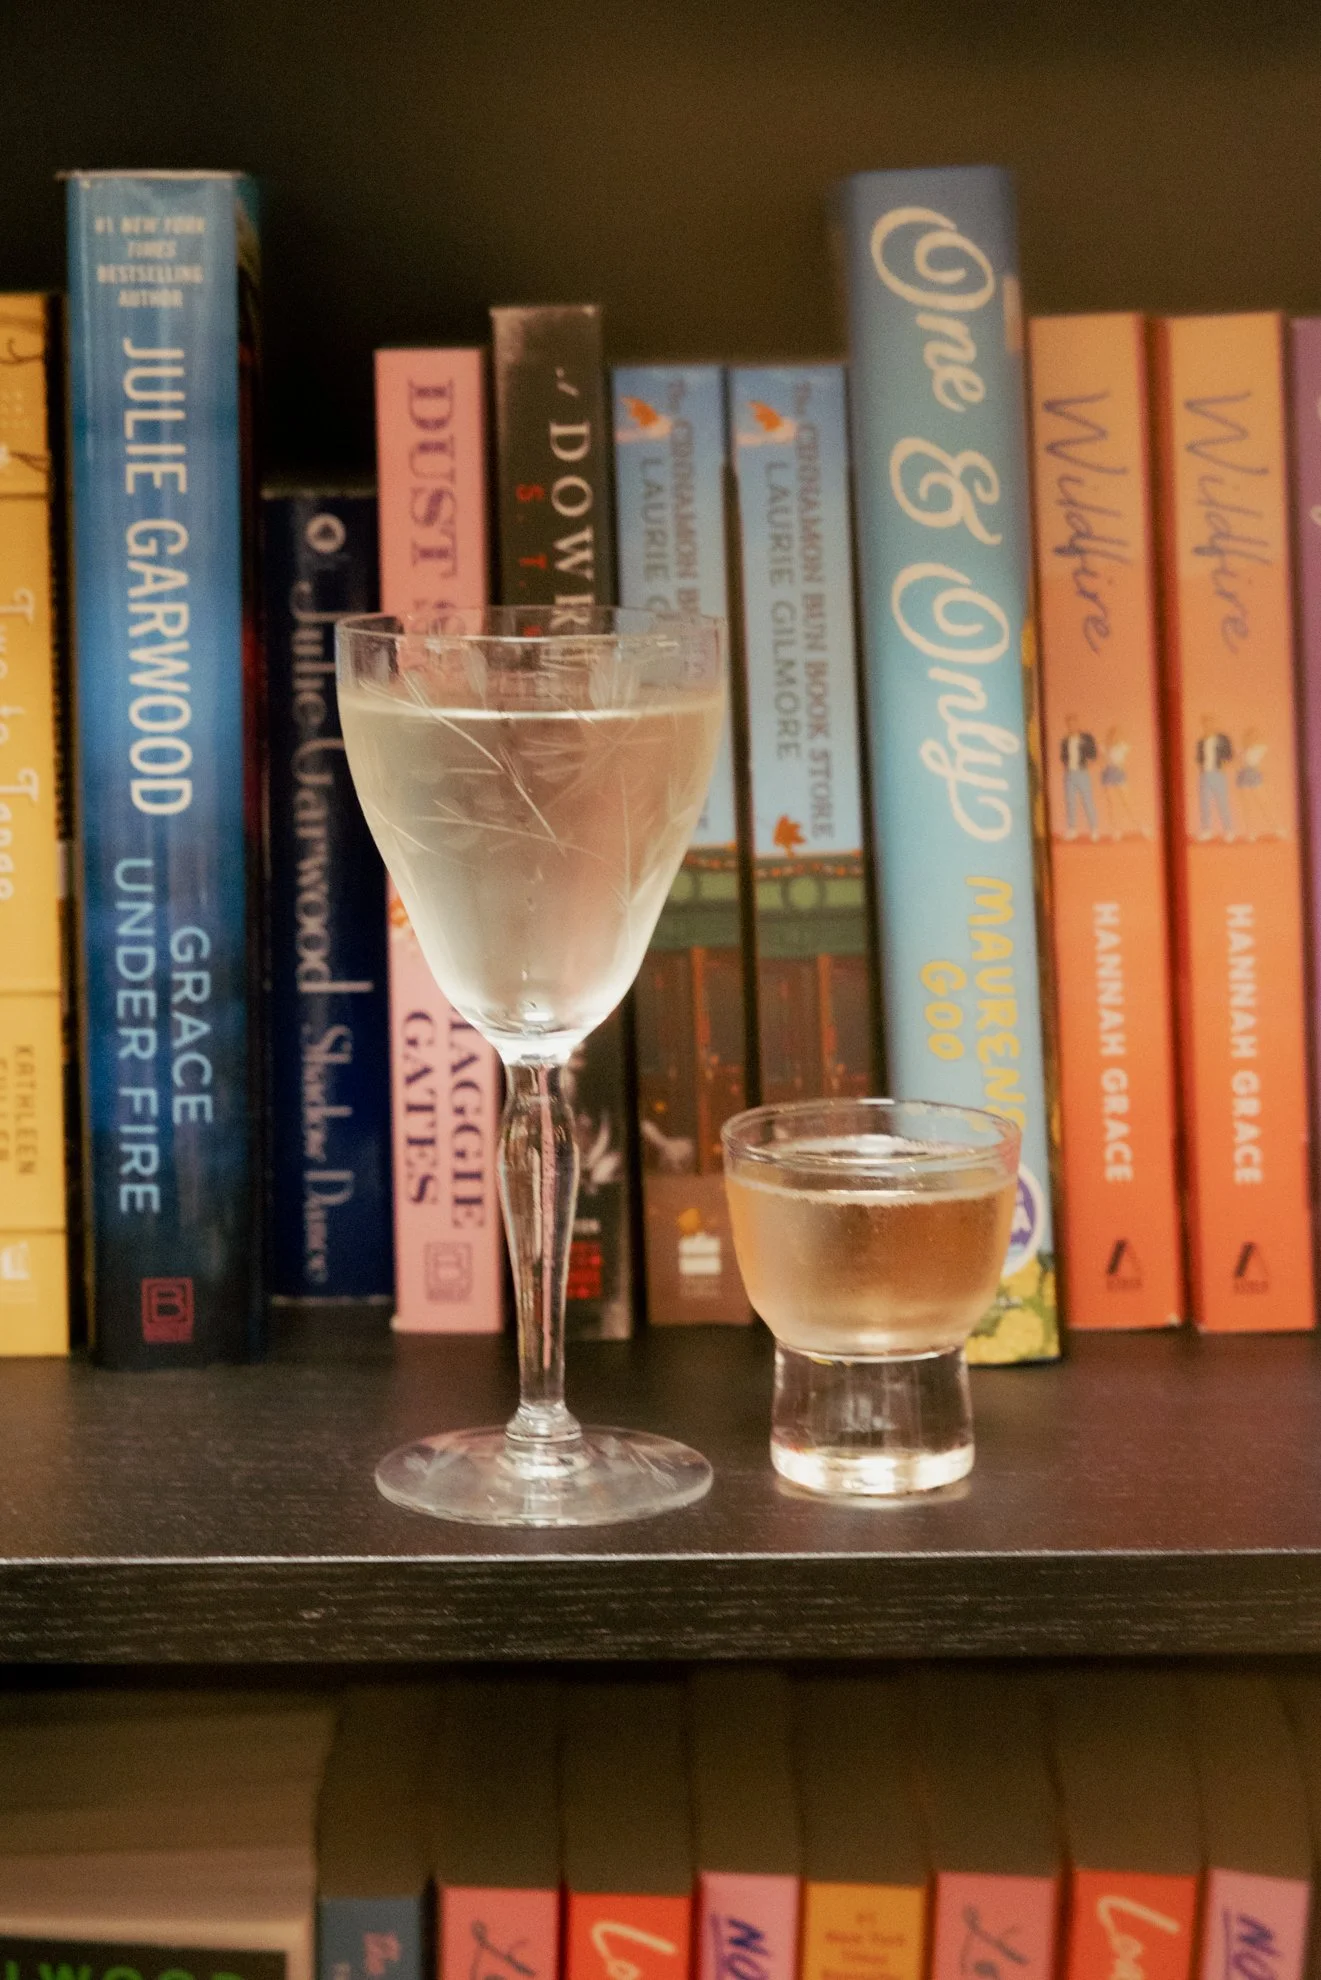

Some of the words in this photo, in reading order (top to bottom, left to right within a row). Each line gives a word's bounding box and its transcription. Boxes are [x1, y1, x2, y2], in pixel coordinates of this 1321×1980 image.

[97, 264, 204, 285] BESTSELLING
[119, 288, 184, 308] AUTHOR
[871, 206, 996, 414] One
[122, 338, 188, 495] JULIE
[407, 379, 459, 580] DUST
[889, 436, 1003, 545] &
[550, 420, 598, 638] DOWR
[640, 457, 670, 582] LAURIE
[765, 461, 795, 586] LAURIE
[796, 423, 825, 583] CINNAMON
[1042, 391, 1132, 655] Wildfire
[1184, 391, 1272, 656] Wildfire
[125, 518, 193, 815] GARWOOD
[291, 580, 342, 733] Julie
[771, 600, 801, 761] GILMORE
[803, 592, 828, 652] BUN
[804, 660, 831, 740] BOOK
[890, 562, 1021, 843] Only
[291, 738, 374, 992] Garwood
[808, 748, 835, 840] STORE
[115, 858, 158, 1058] UNDER
[170, 924, 214, 1125] GRACE
[920, 960, 967, 1060] GOO
[1093, 903, 1126, 1057] HANNAH
[1226, 903, 1259, 1059] HANNAH
[118, 1088, 161, 1213] FIRE
[302, 1025, 354, 1162] Shadow
[403, 1010, 439, 1205] GATES
[1100, 1067, 1134, 1184] GRACE
[1231, 1070, 1264, 1186] GRACE
[303, 1170, 354, 1283] Dance
